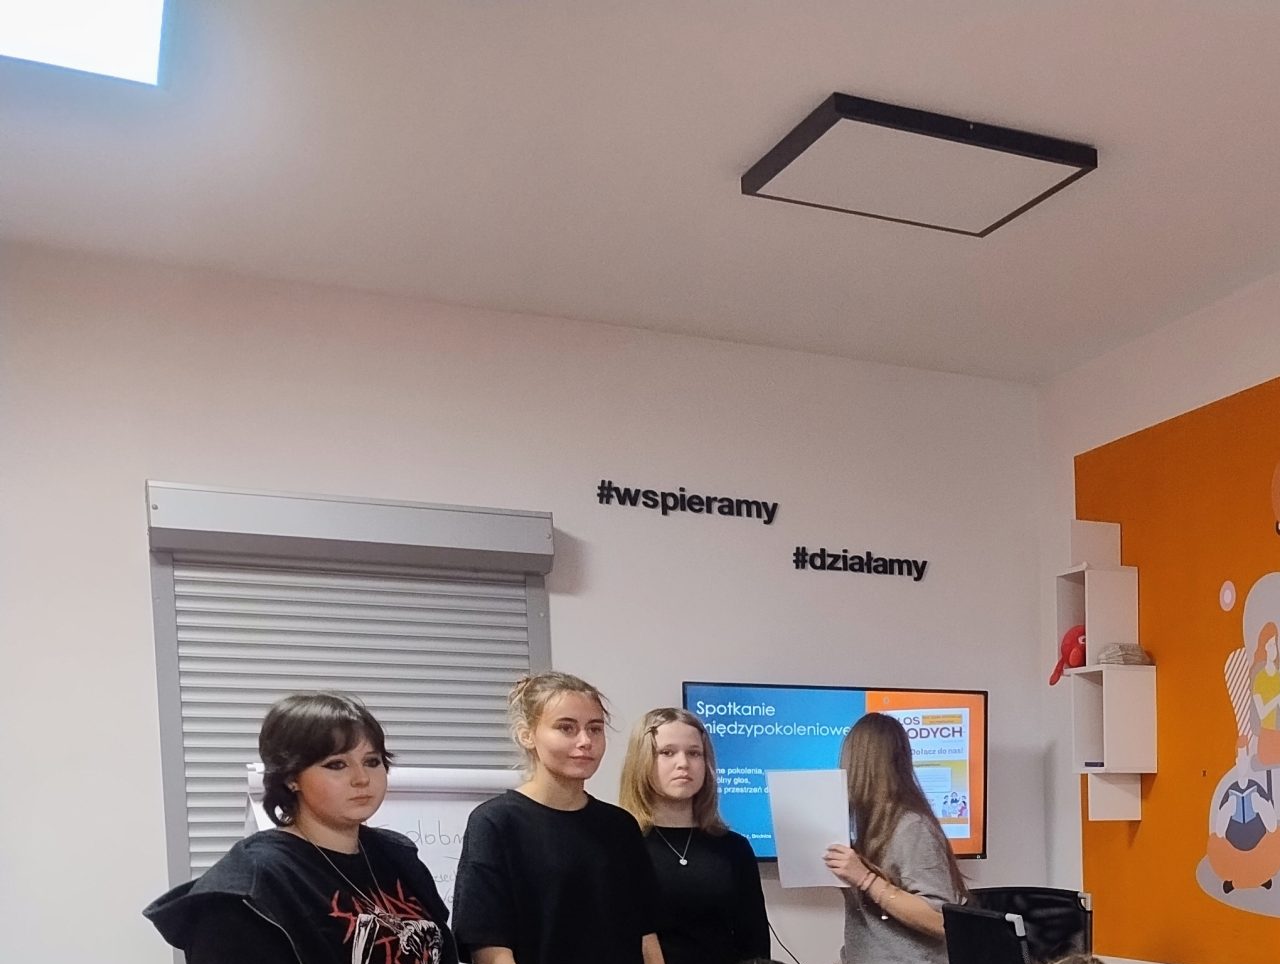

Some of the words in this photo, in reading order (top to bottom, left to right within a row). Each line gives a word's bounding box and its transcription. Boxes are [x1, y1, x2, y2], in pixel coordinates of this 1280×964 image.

[597, 480, 779, 525] #wspieramy
[793, 546, 928, 582] #działamy
[696, 700, 776, 717] Spotkanie
[907, 726, 963, 740] ODYCH
